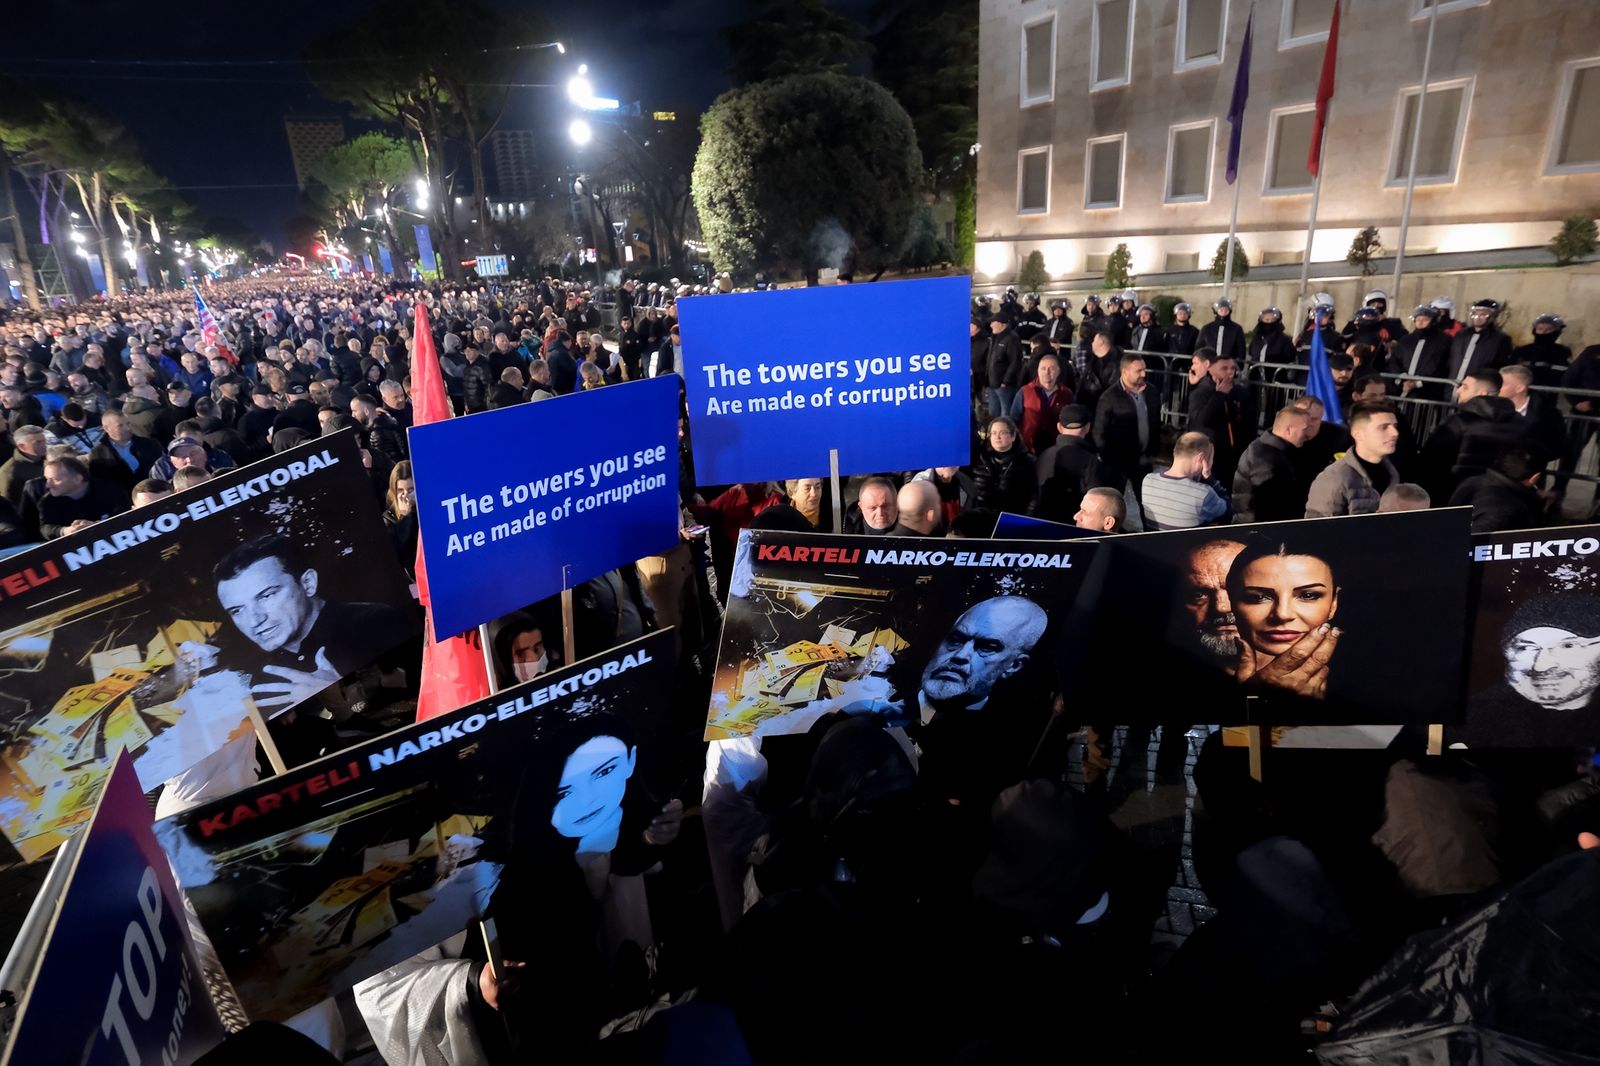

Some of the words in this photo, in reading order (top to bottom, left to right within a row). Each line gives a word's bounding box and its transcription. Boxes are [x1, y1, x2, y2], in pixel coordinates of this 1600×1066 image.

[703, 364, 752, 387] The
[757, 360, 849, 383] towers
[854, 357, 902, 382] you
[908, 353, 951, 374] see
[706, 397, 743, 416] Are
[748, 391, 806, 413] made
[811, 387, 834, 408] of
[839, 380, 951, 406] corruption
[62, 450, 340, 571] NARKO-ELEKTORAL
[441, 494, 494, 524] The
[500, 468, 585, 508] towers
[589, 456, 628, 488] you
[633, 445, 667, 468] see
[446, 532, 486, 557] Are
[491, 508, 547, 542] made
[551, 497, 573, 521] of
[575, 473, 666, 513] corruption
[758, 544, 860, 564] KARTELI
[864, 549, 1072, 568] NARKO-ELEKTORAL
[199, 761, 361, 837] KARTELI
[368, 649, 653, 772] NARKO-ELEKTORAL
[101, 866, 167, 1066] TOP
